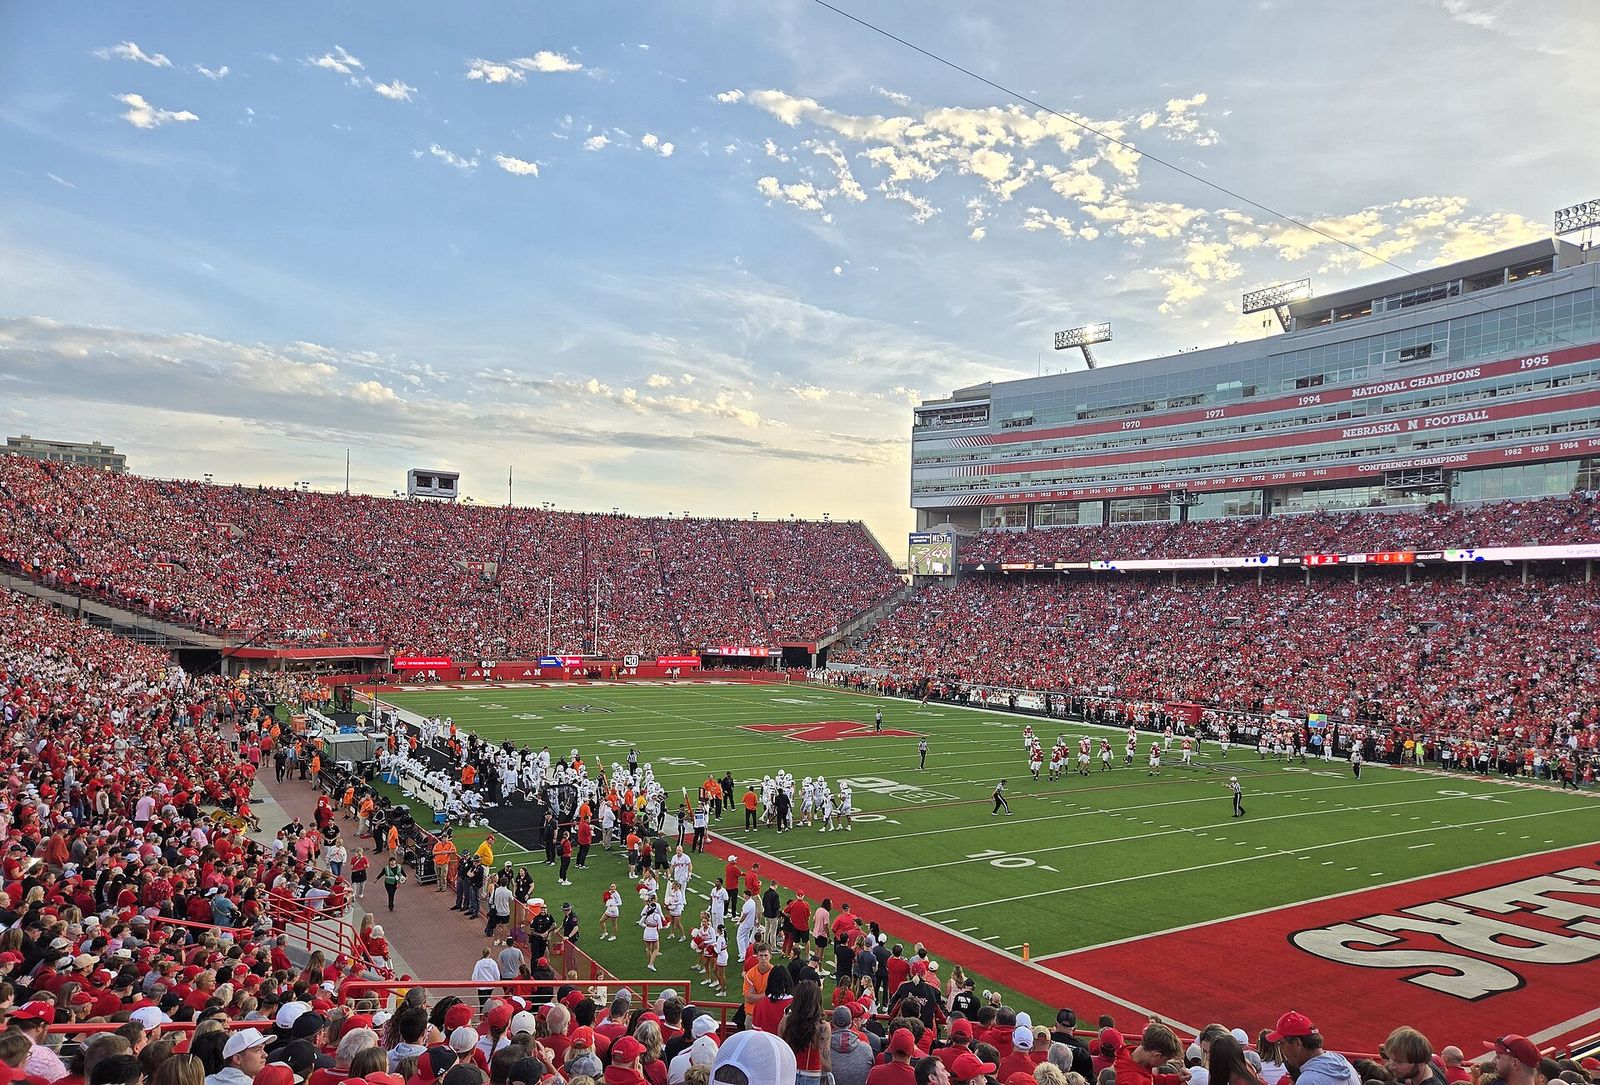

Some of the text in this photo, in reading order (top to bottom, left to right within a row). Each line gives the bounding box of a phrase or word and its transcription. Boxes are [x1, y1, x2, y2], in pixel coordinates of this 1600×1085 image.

[1520, 355, 1549, 370] 1995
[1352, 368, 1481, 398] NATIONAL CHAMPIONS
[1298, 394, 1320, 406] 1994
[1206, 410, 1224, 418] 1971
[1122, 420, 1140, 430] 1970
[1342, 410, 1488, 438] NEBRASKA N FOOTBALL
[1560, 442, 1578, 450] 1984
[1358, 454, 1468, 472] CONFERENCE CHAMPIONS
[965, 849, 1036, 868] 10
